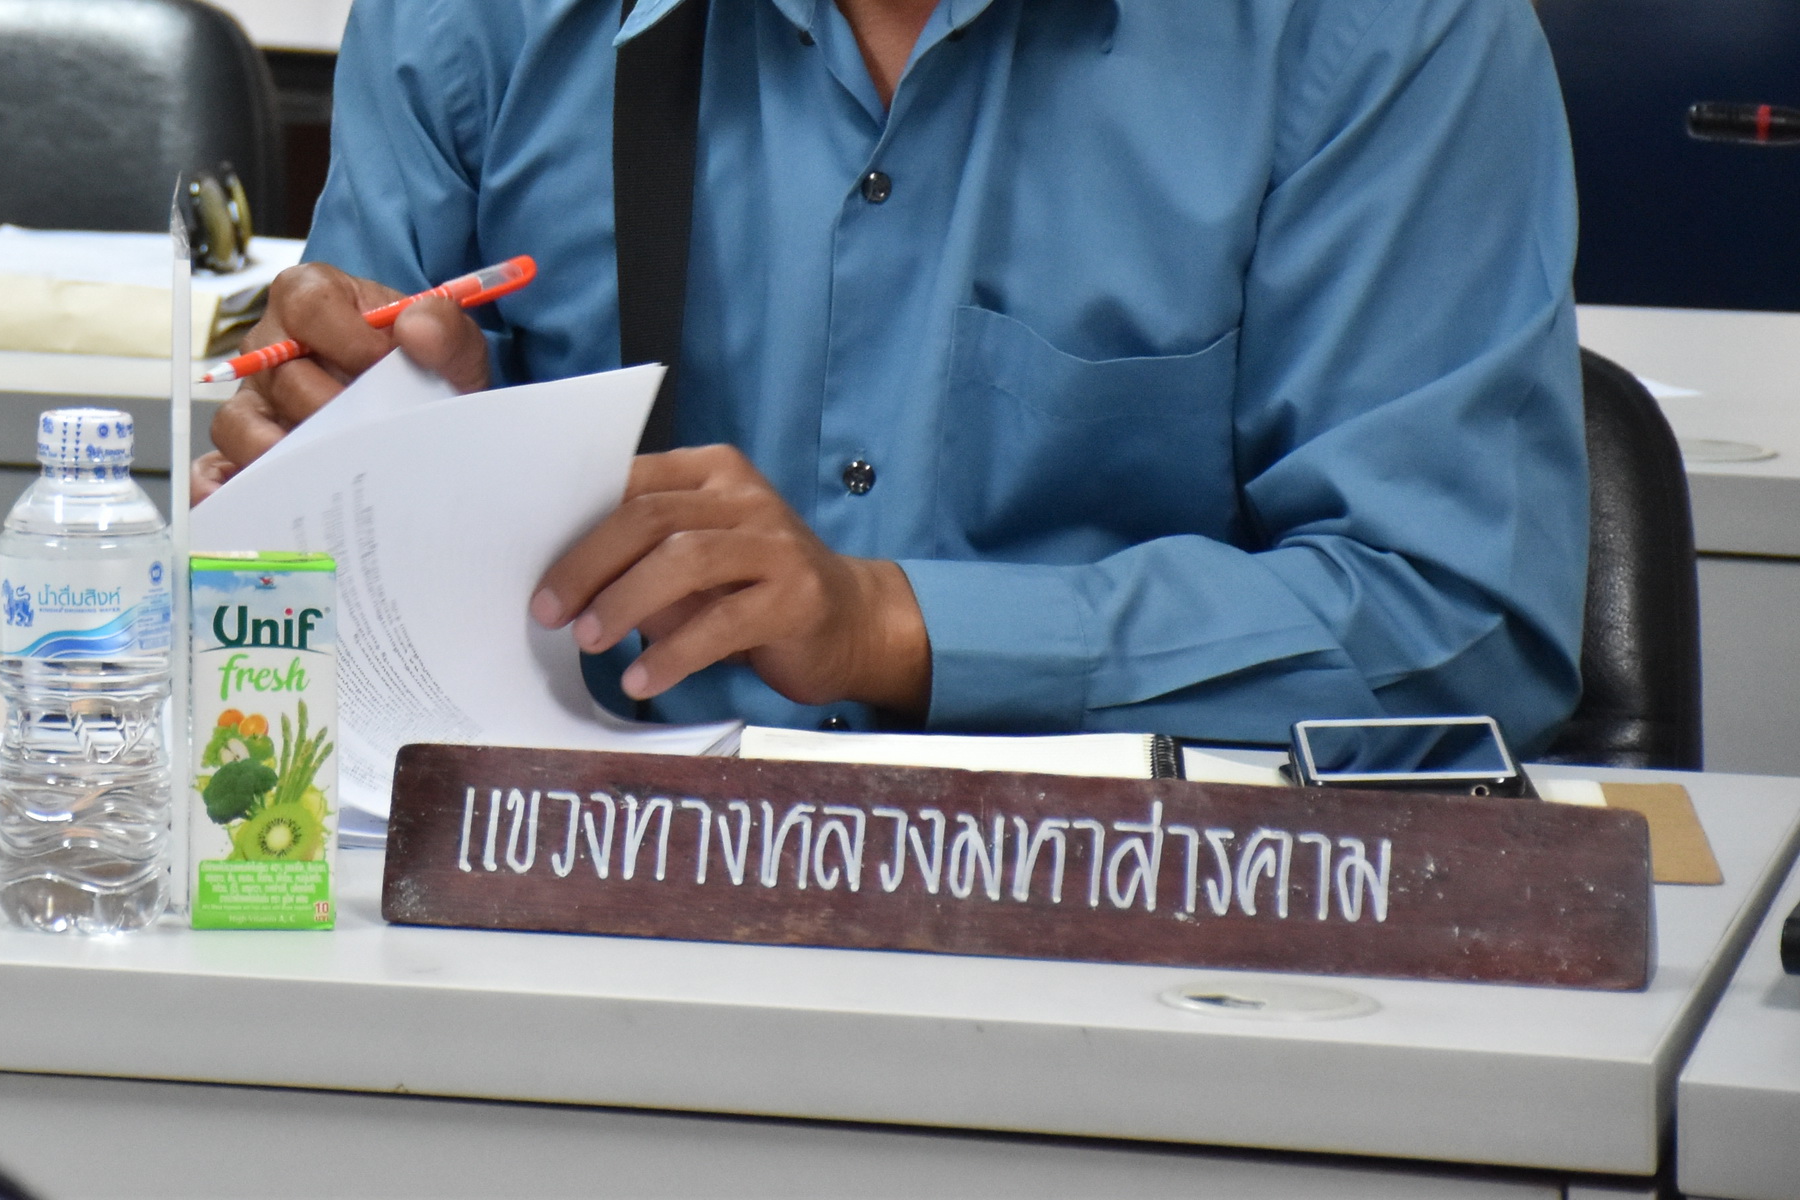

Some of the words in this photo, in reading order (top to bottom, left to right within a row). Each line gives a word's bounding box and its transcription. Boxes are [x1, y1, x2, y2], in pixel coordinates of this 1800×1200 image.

[38, 584, 122, 607] น้ำดื่มสิงห์
[212, 605, 324, 650] Unif
[218, 653, 311, 702] fresh
[459, 786, 1392, 922] แขวงทางหลวงมหาสารคาม
[314, 901, 329, 914] 10
